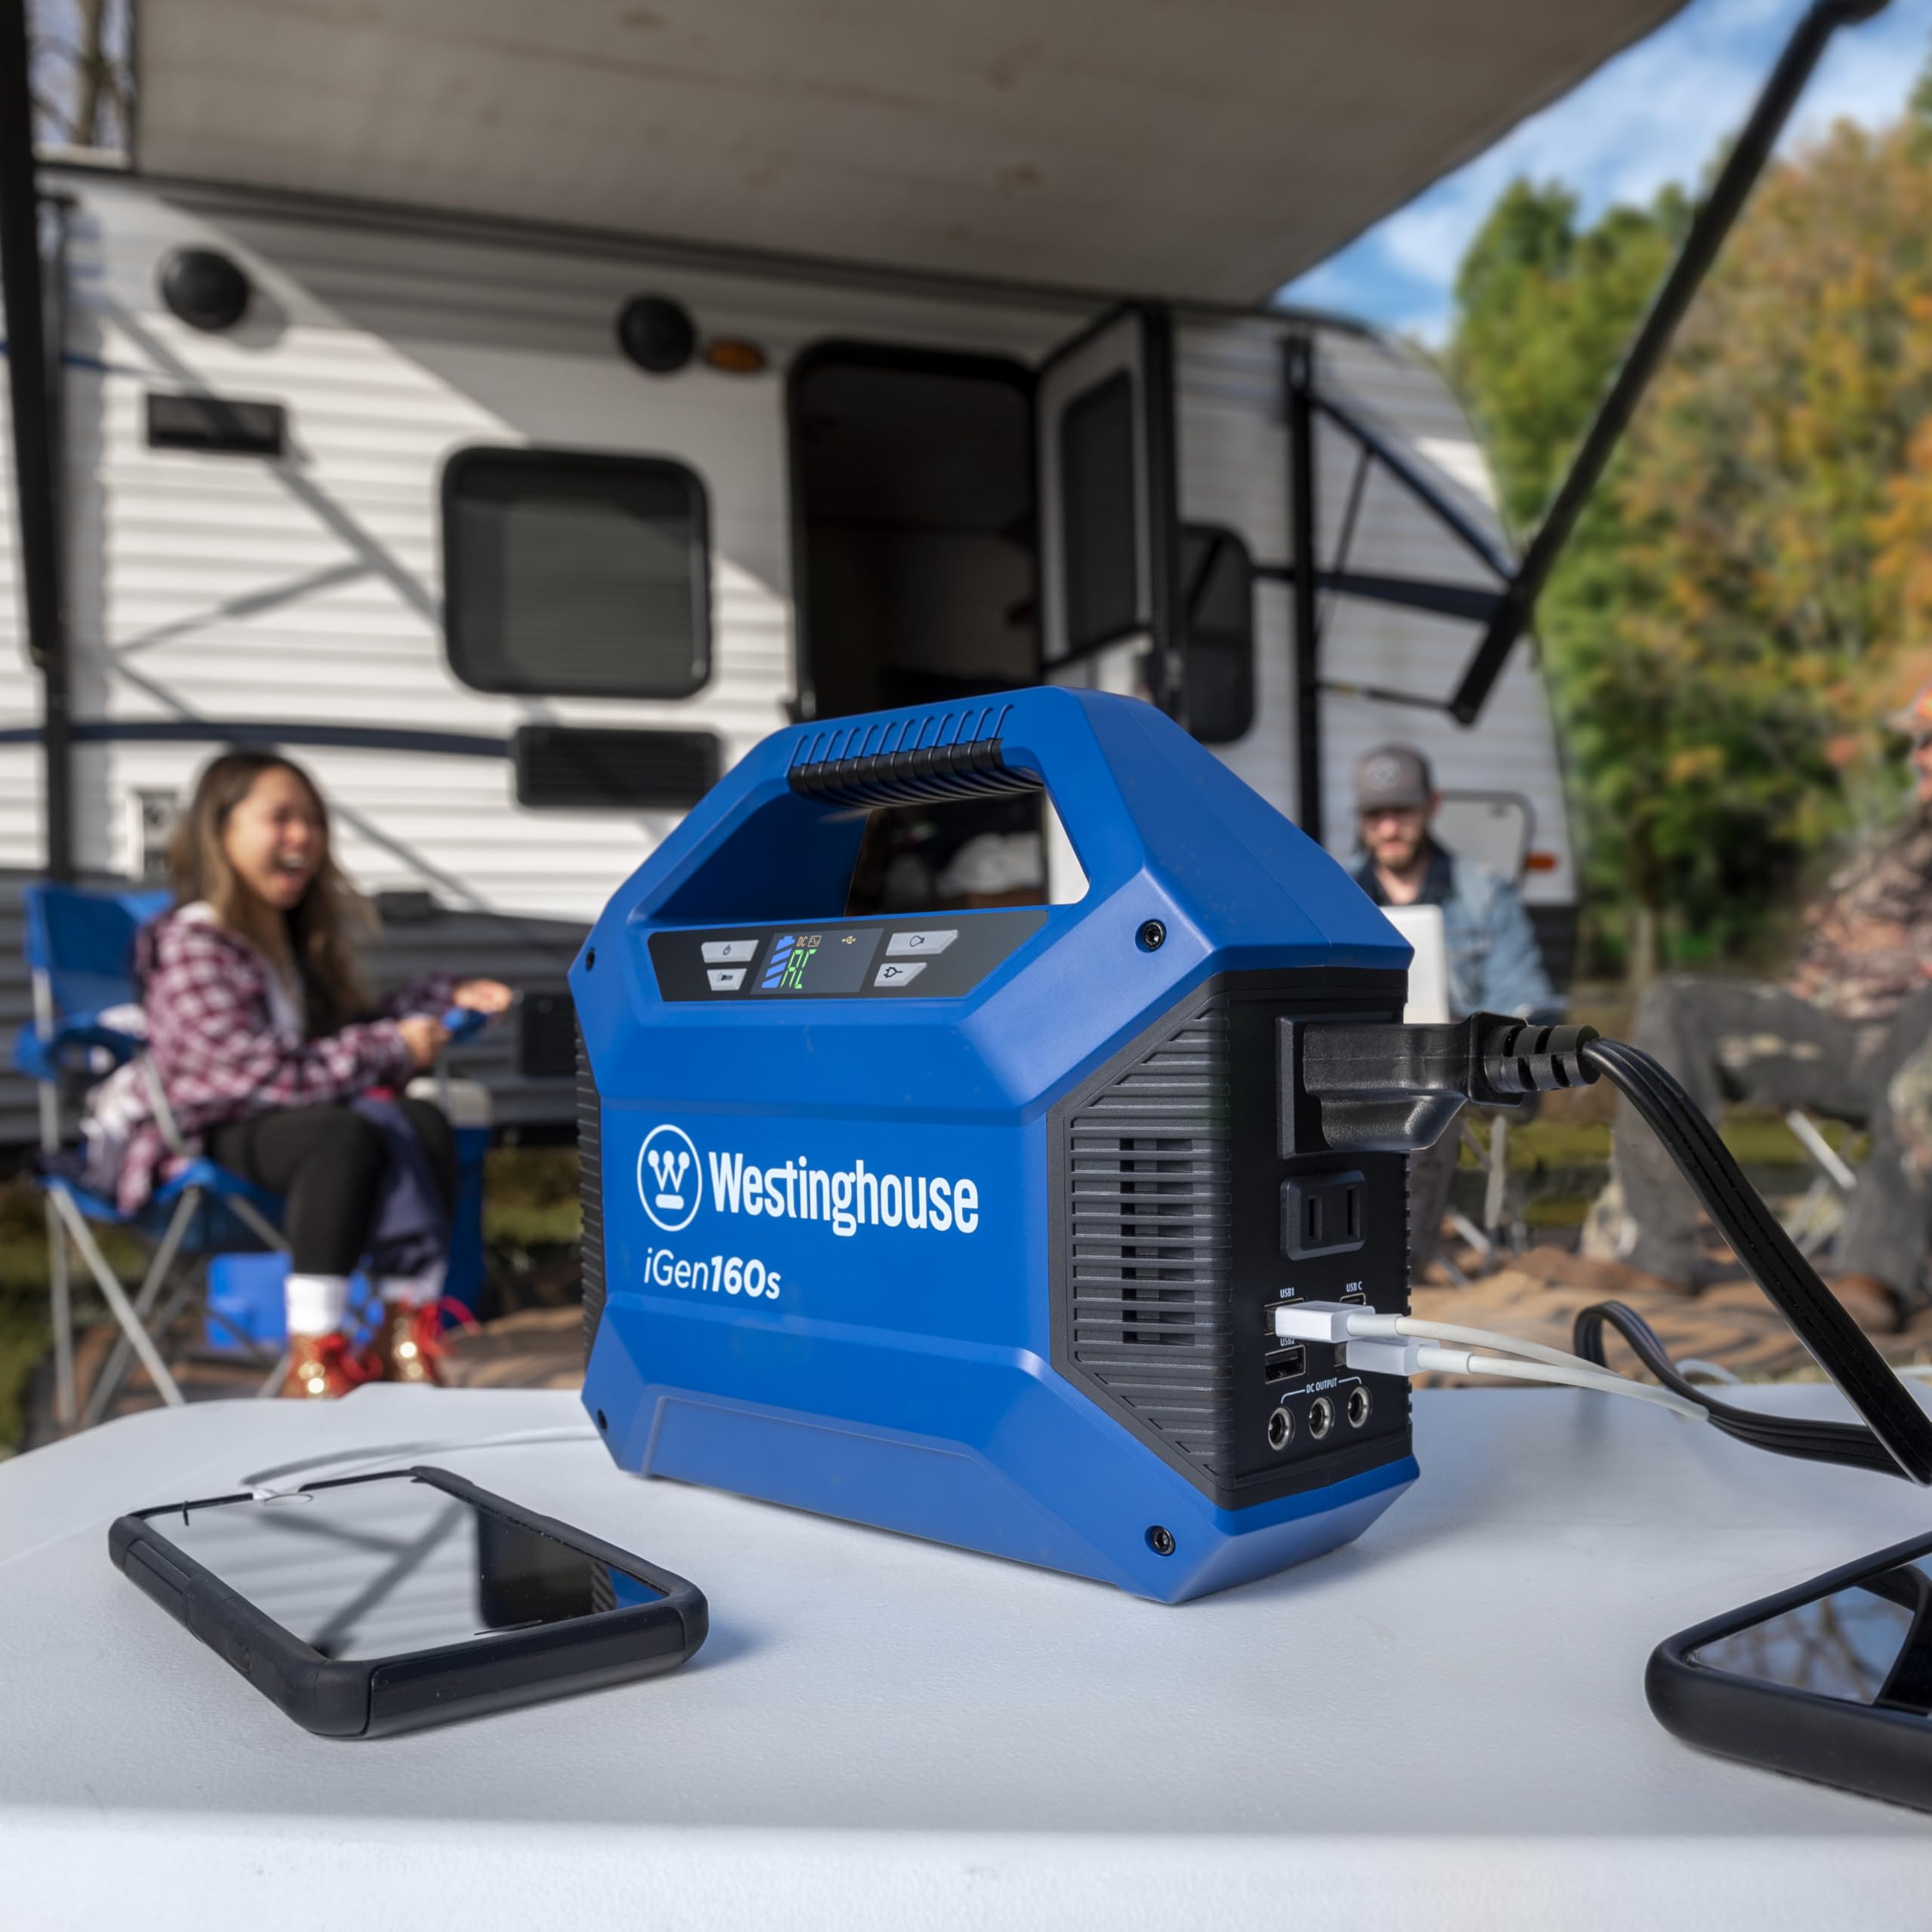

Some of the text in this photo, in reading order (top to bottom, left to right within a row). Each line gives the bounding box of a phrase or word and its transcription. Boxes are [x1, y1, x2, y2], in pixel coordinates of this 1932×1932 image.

[796, 936, 808, 947] DC
[780, 949, 817, 989] AC
[708, 1151, 980, 1238] Westinghouse
[644, 1247, 782, 1300] iGen160s
[1280, 1287, 1294, 1298] USB1
[1346, 1281, 1363, 1292] USB C
[1306, 1377, 1337, 1393] DC OUTPUT
